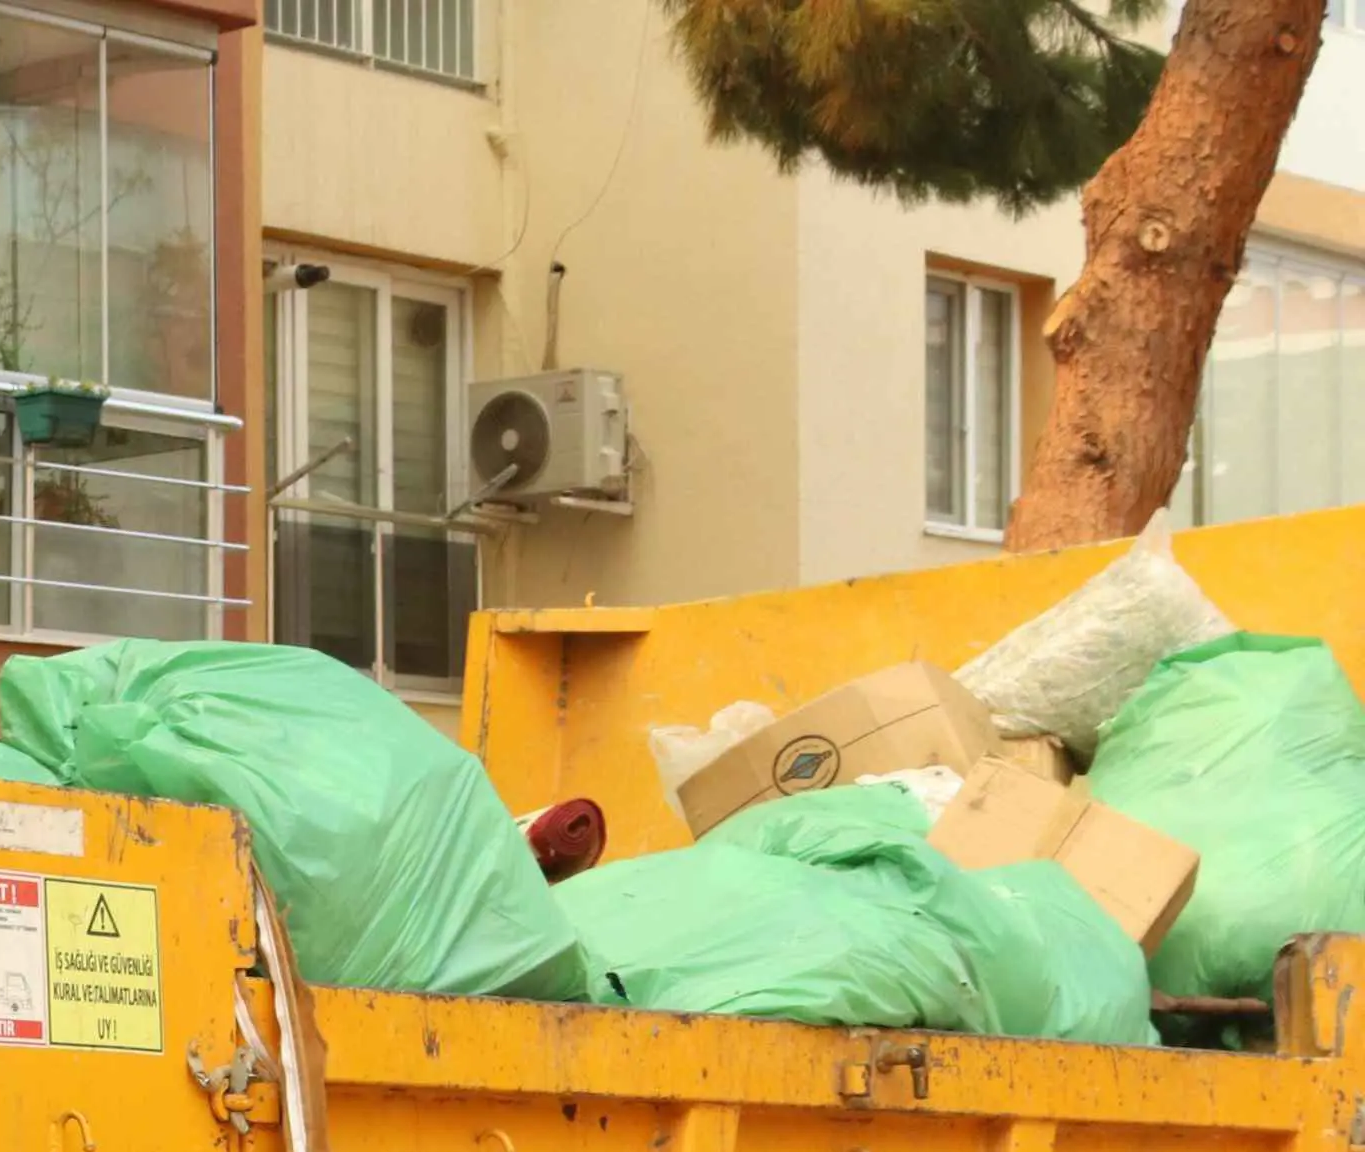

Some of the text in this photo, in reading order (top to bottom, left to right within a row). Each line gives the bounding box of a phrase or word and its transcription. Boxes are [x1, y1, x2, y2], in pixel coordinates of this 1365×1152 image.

[98, 955, 109, 973] VE
[53, 983, 81, 1001] KURAL
[81, 984, 93, 1002] VE
